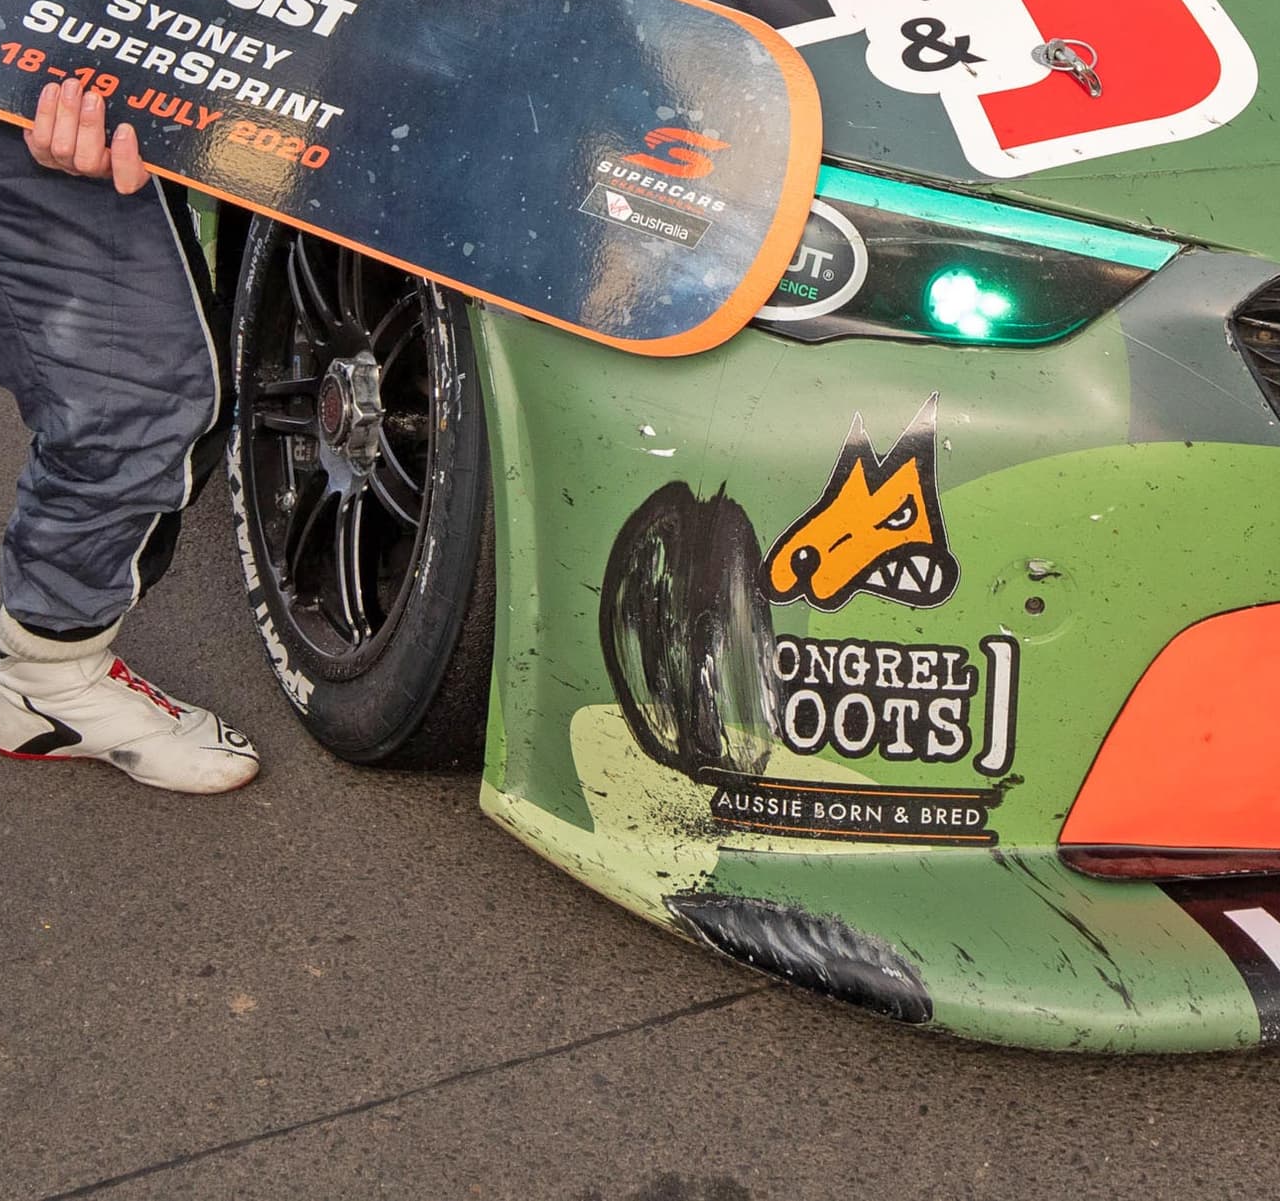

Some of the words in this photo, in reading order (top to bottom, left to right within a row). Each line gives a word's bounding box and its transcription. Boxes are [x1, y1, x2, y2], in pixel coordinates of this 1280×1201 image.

[901, 16, 985, 71] &
[126, 89, 224, 131] JULY
[227, 120, 329, 170] 2020
[597, 161, 726, 212] SUPERCARS
[631, 212, 688, 240] australia
[773, 641, 970, 691] ONGREL
[785, 689, 964, 756] OOTS
[718, 792, 802, 817] AUSSIE
[814, 803, 883, 823] BORN
[895, 807, 909, 824] &
[921, 808, 980, 826] BRED
